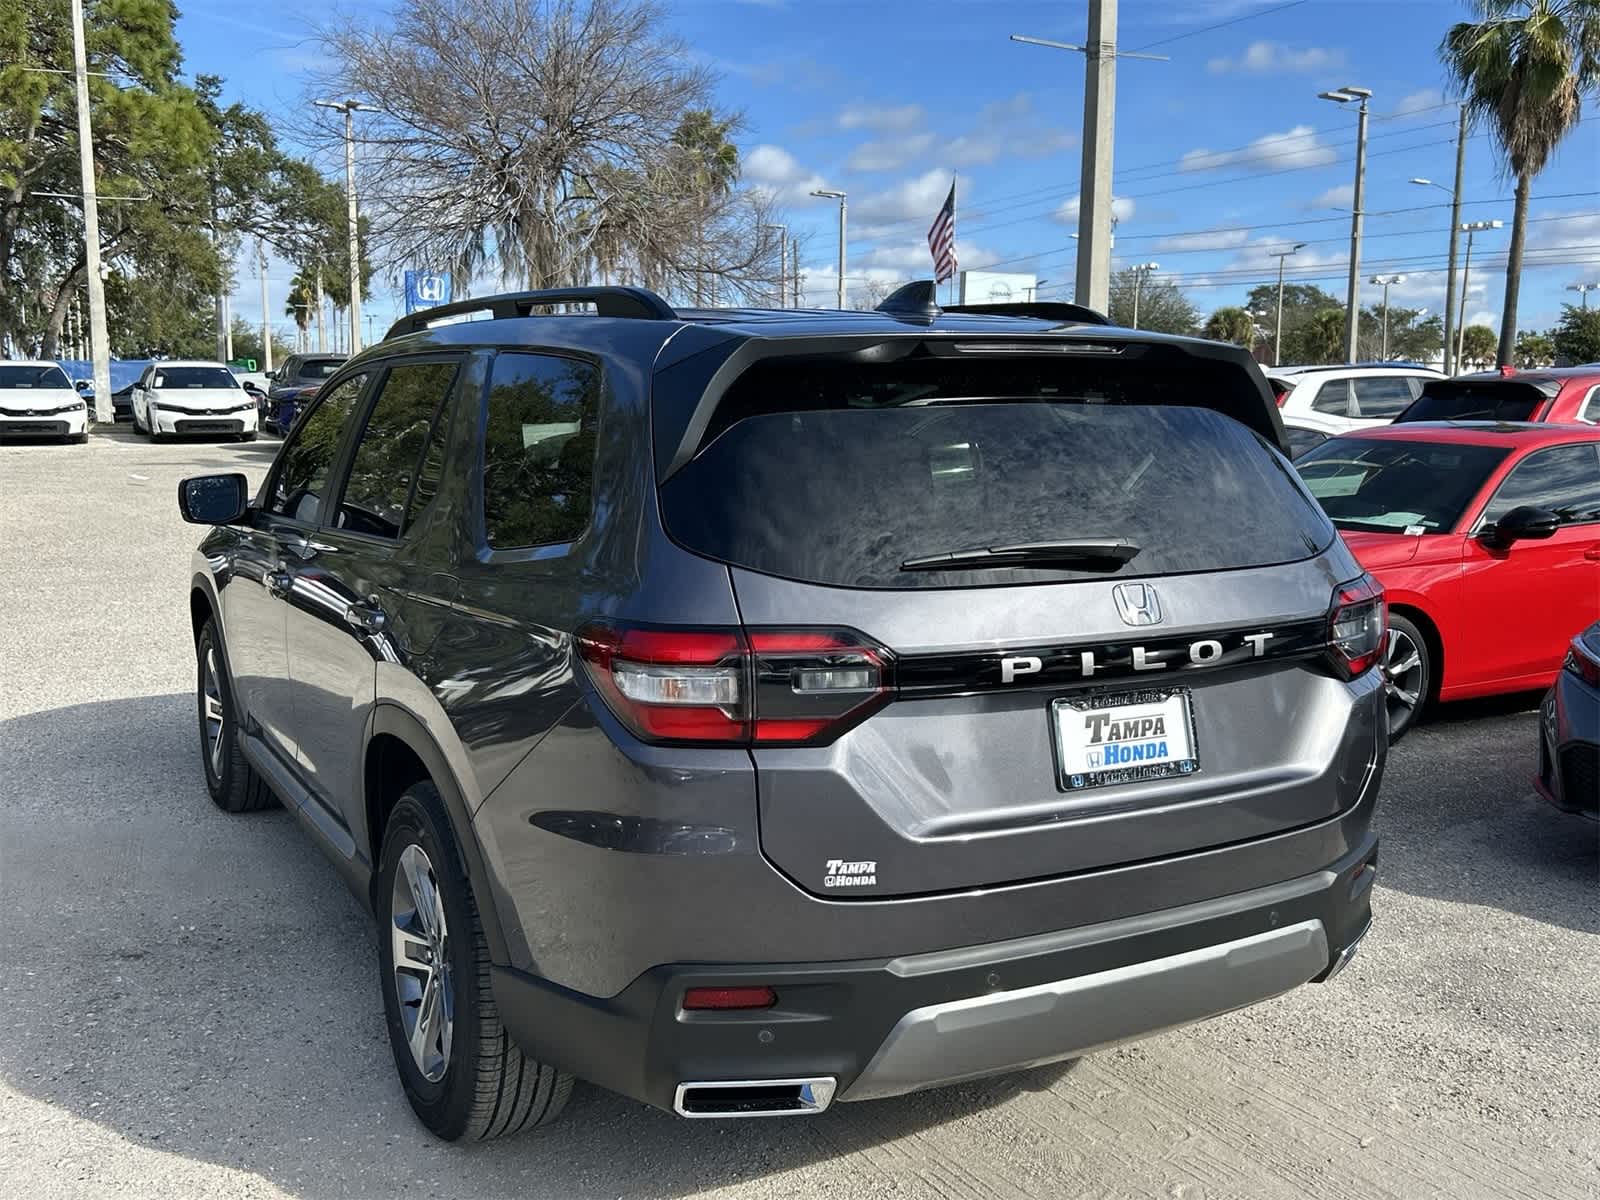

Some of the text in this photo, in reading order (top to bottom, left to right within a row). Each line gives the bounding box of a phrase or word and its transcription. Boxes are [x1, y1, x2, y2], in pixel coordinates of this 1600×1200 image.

[1001, 632, 1274, 683] PILOT
[1085, 713, 1166, 744] TAMPA
[1104, 741, 1168, 766] HONDA
[826, 859, 877, 875] TAMPA
[836, 875, 877, 887] HONDA
